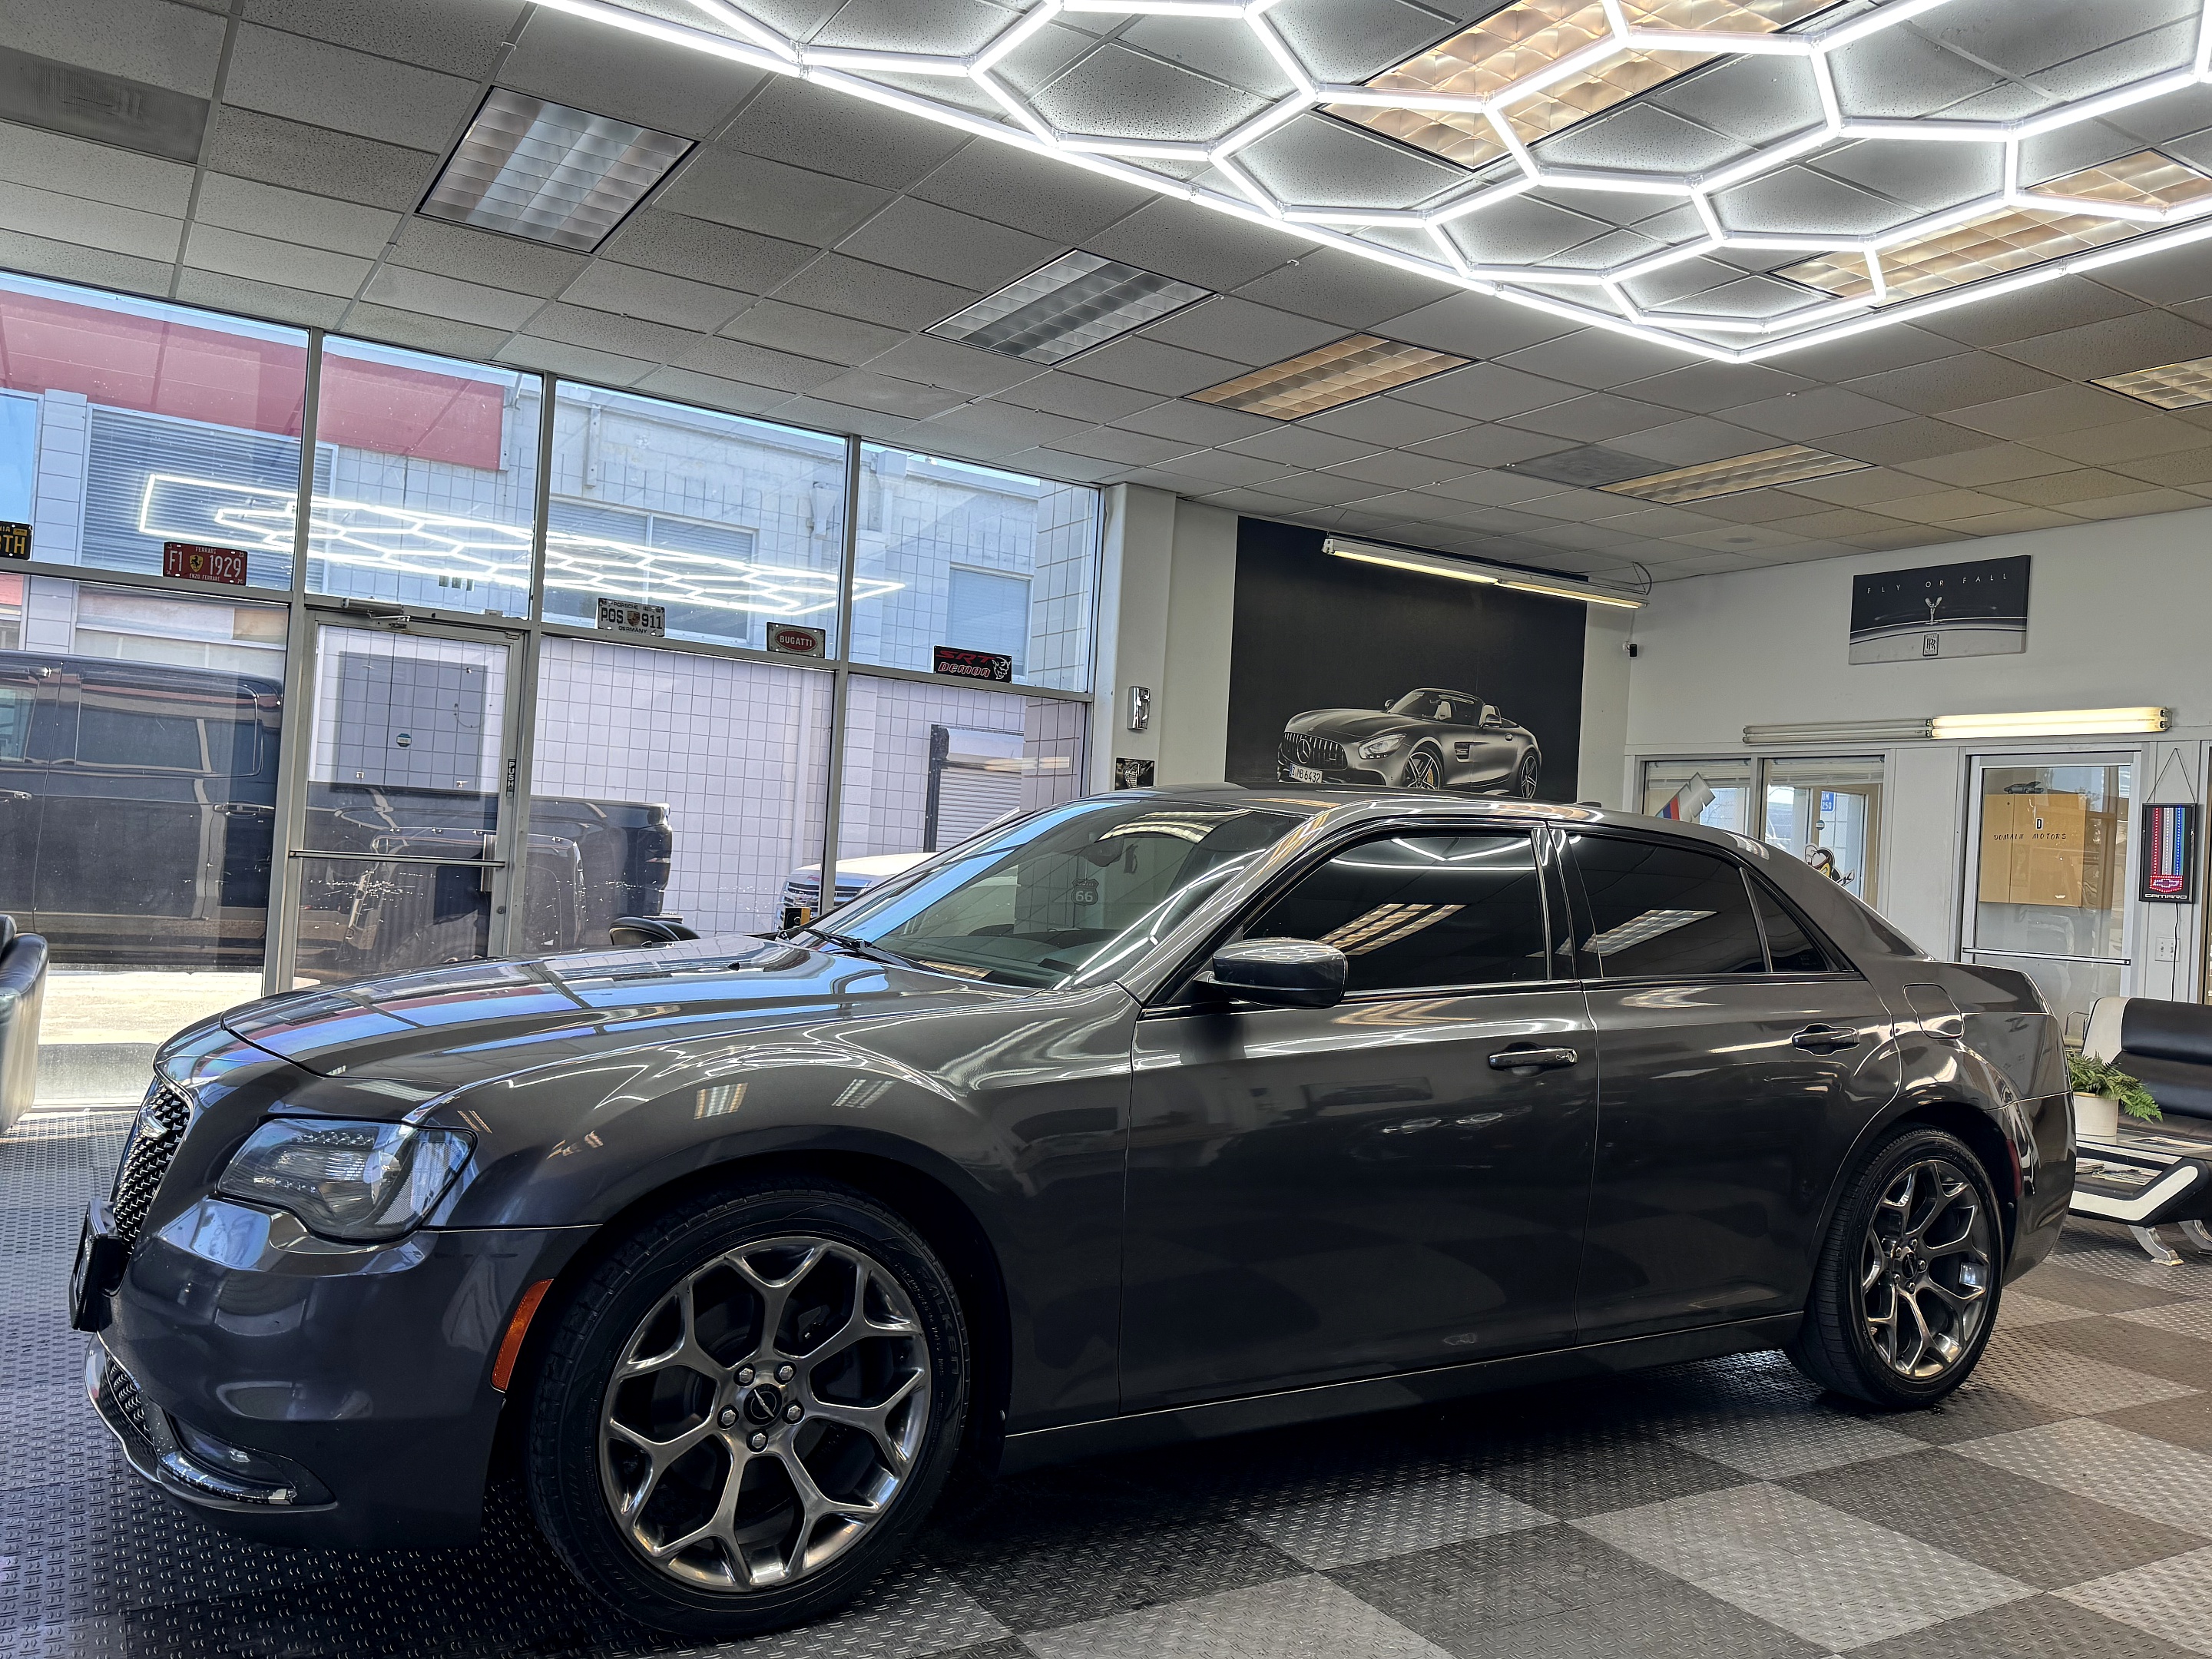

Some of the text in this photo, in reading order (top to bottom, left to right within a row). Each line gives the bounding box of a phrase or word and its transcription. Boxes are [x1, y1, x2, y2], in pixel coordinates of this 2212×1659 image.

[0, 535, 25, 555] TH
[169, 550, 242, 578] F1 1929
[1867, 573, 2007, 594] FLY OR FALL
[614, 601, 639, 610] PORSCHE
[601, 607, 624, 624] POS
[641, 613, 663, 630] 911
[618, 625, 648, 634] GERMANY
[780, 635, 813, 647] BUGATTI
[935, 650, 997, 665] SRT
[1304, 770, 1321, 783] 6432
[2036, 818, 2043, 830] D
[1076, 891, 1093, 902] 66
